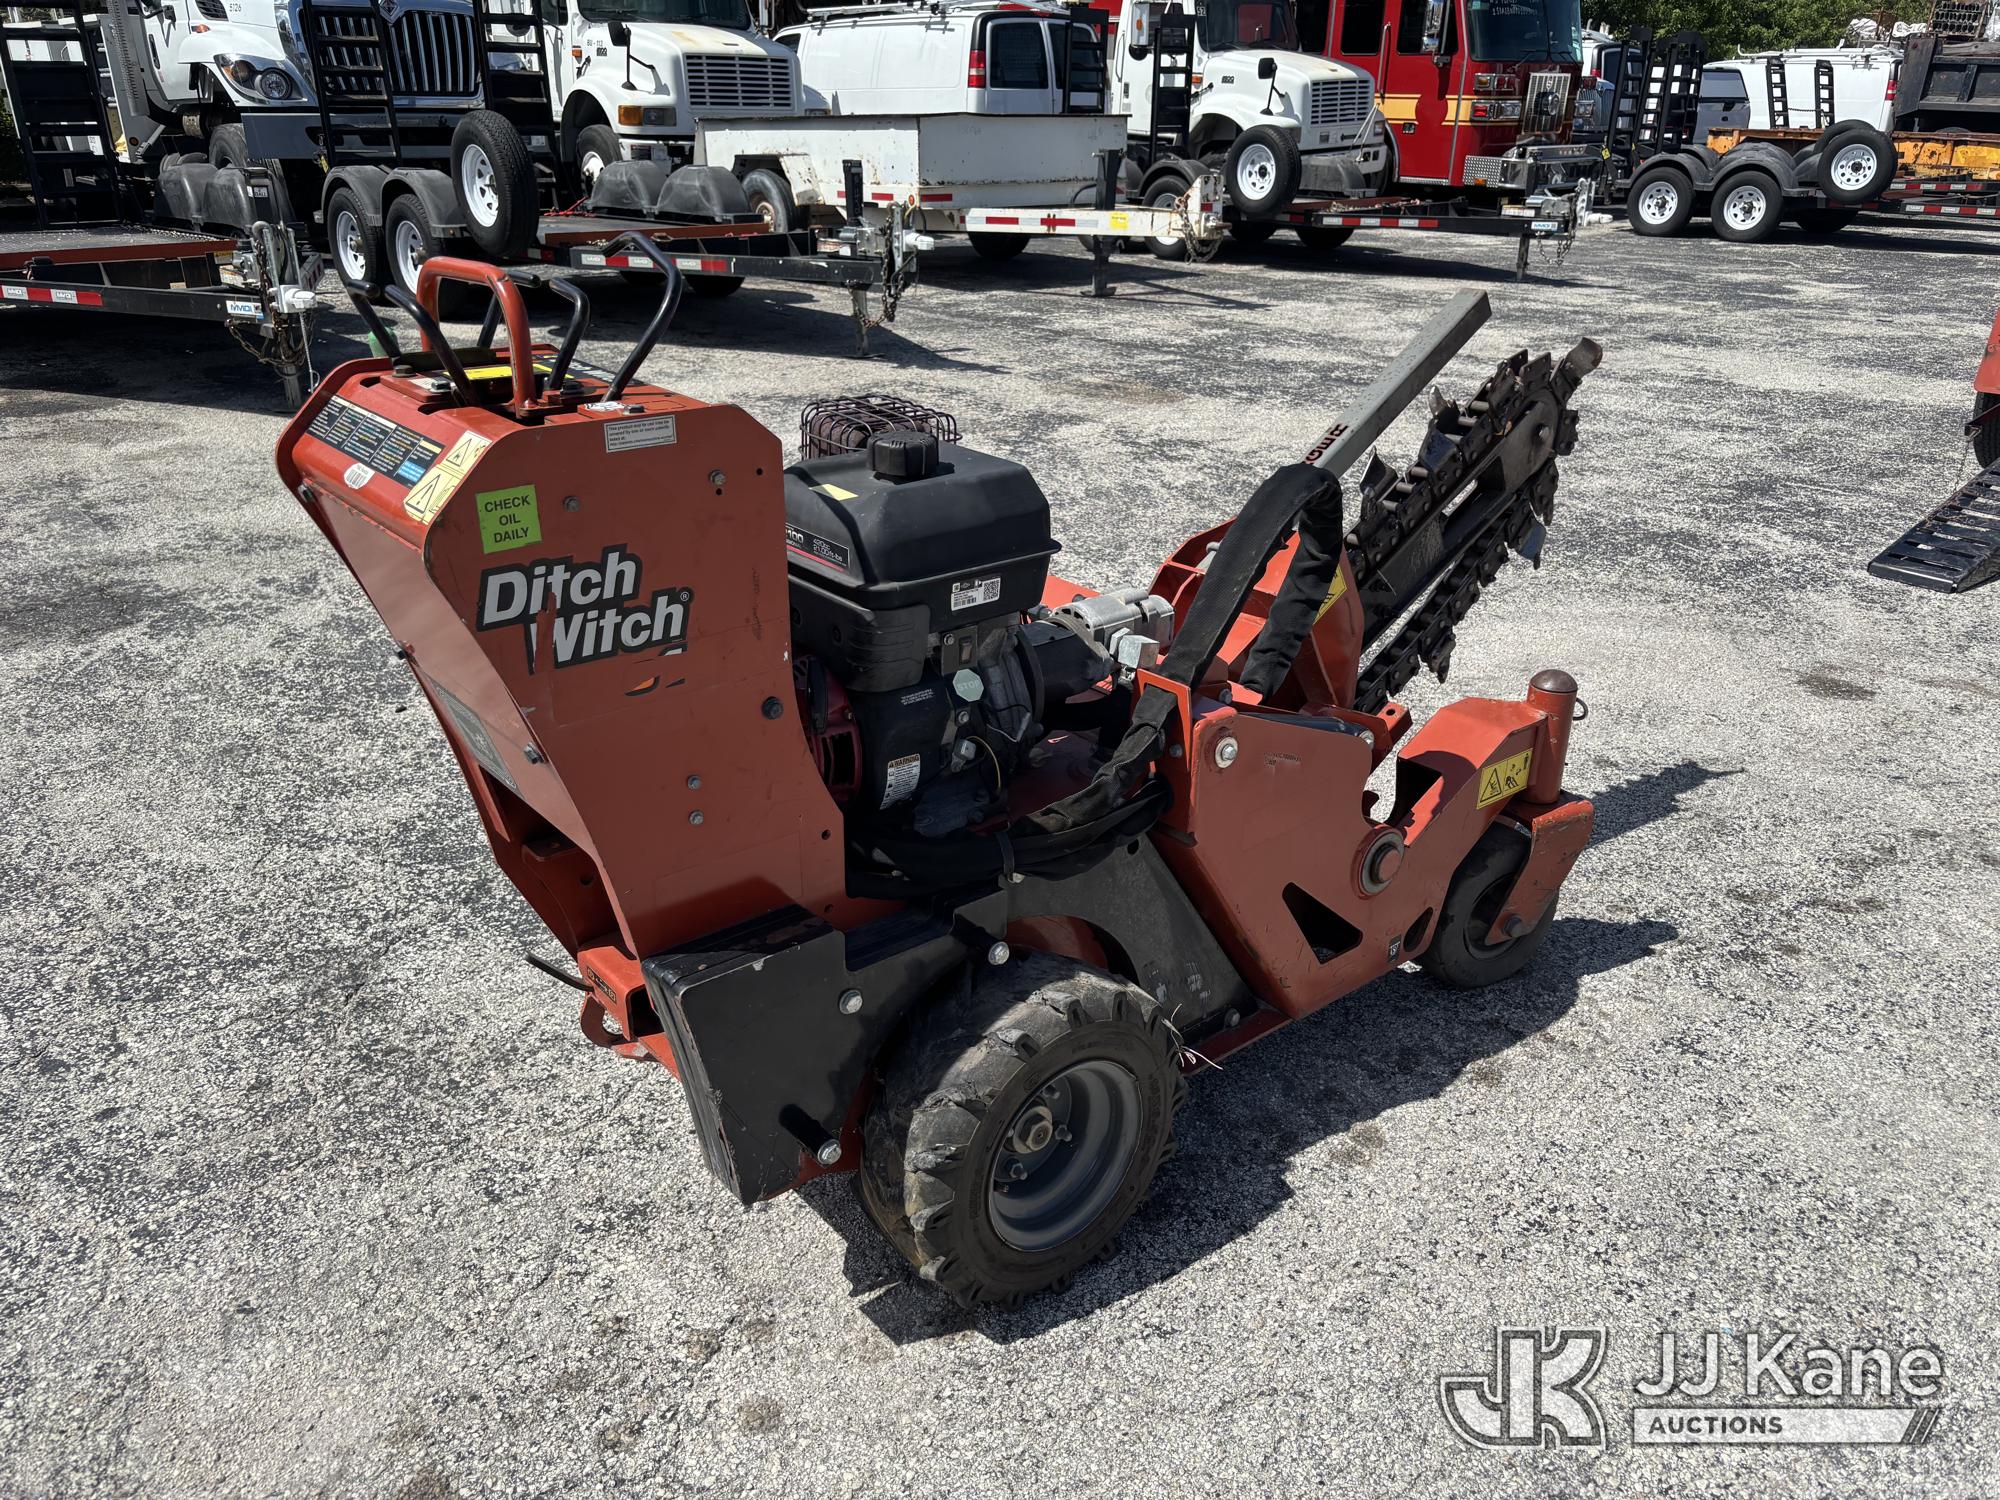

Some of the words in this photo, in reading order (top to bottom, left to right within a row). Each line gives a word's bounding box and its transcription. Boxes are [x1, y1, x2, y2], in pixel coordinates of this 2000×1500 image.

[484, 495, 531, 513] CHECK
[499, 513, 521, 527] OIL
[493, 527, 530, 543] DAILY
[482, 551, 637, 625] Ditch
